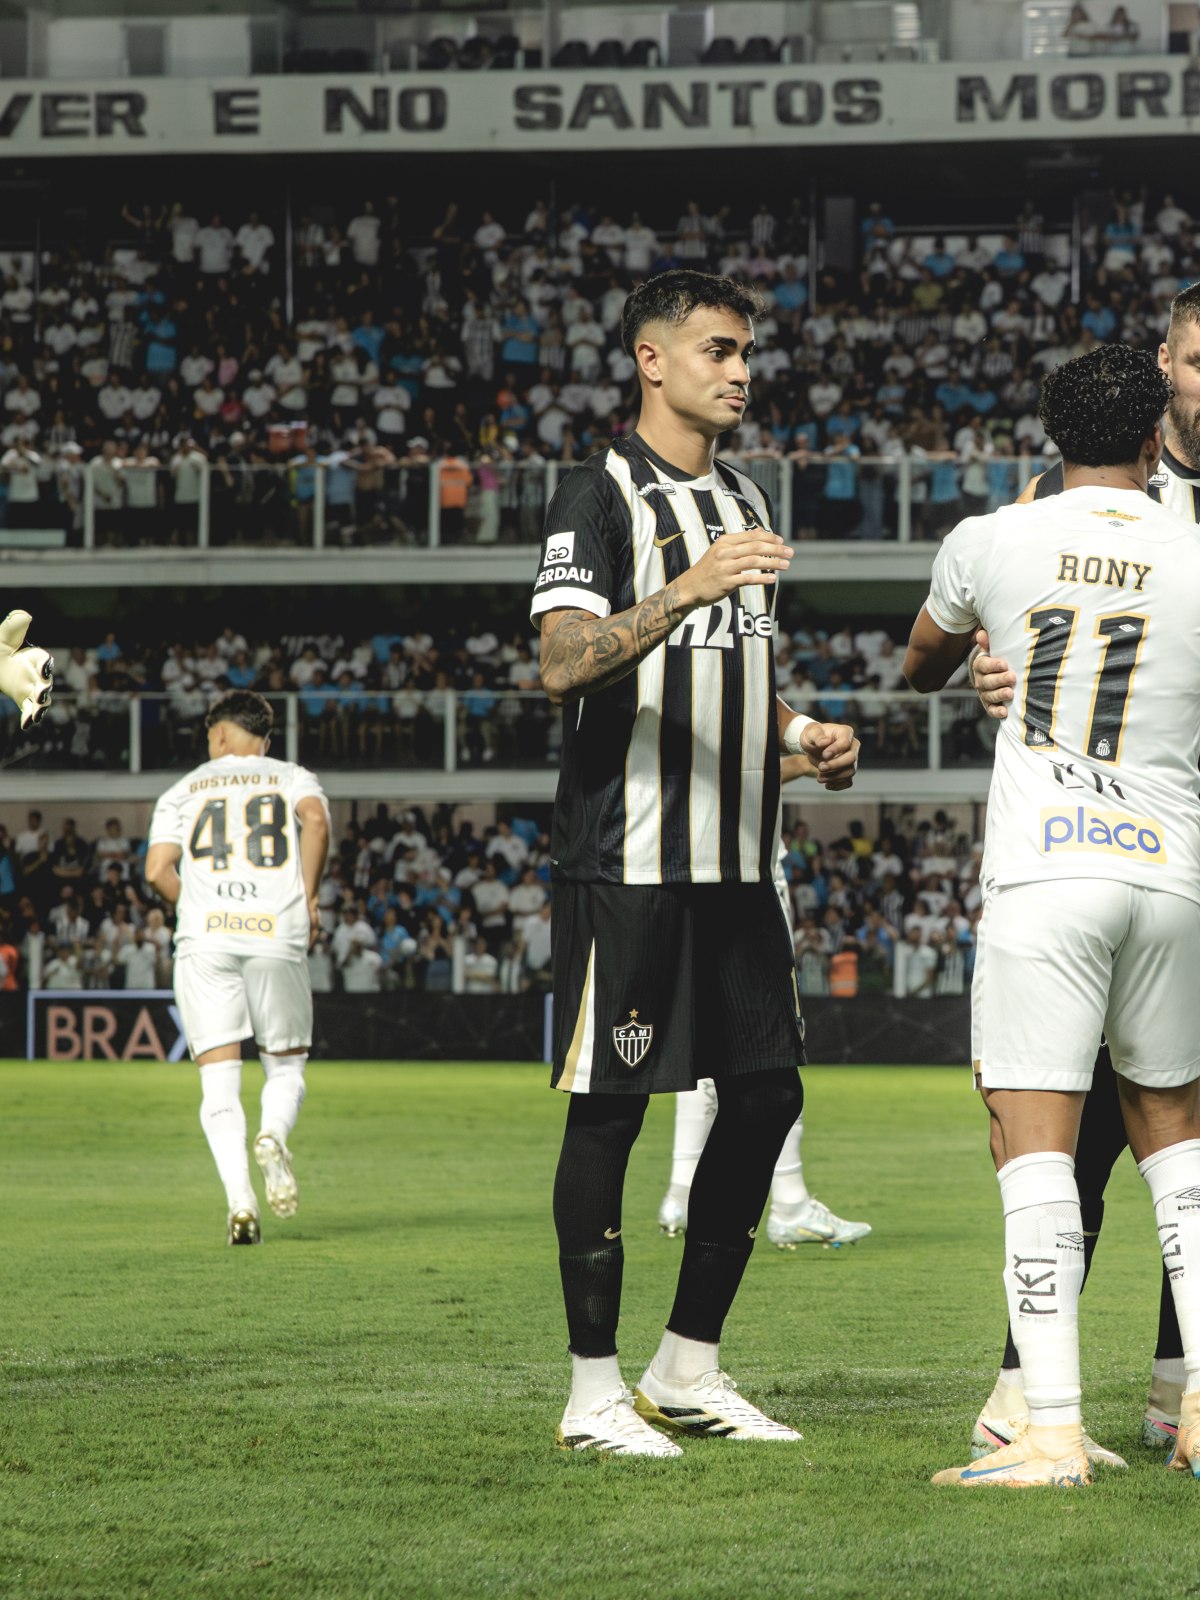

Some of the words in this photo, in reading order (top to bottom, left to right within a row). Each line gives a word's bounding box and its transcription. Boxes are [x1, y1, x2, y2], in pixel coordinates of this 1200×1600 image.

[213, 89, 260, 135] E
[324, 87, 448, 134] NO
[513, 78, 883, 131] SANTOS
[1056, 554, 1152, 592] RONY
[1021, 603, 1151, 767] 11
[189, 774, 261, 793] GUSTAVO
[189, 793, 290, 873] 48
[1044, 806, 1161, 854] placo
[206, 912, 273, 933] placo
[618, 1029, 647, 1038] CAM
